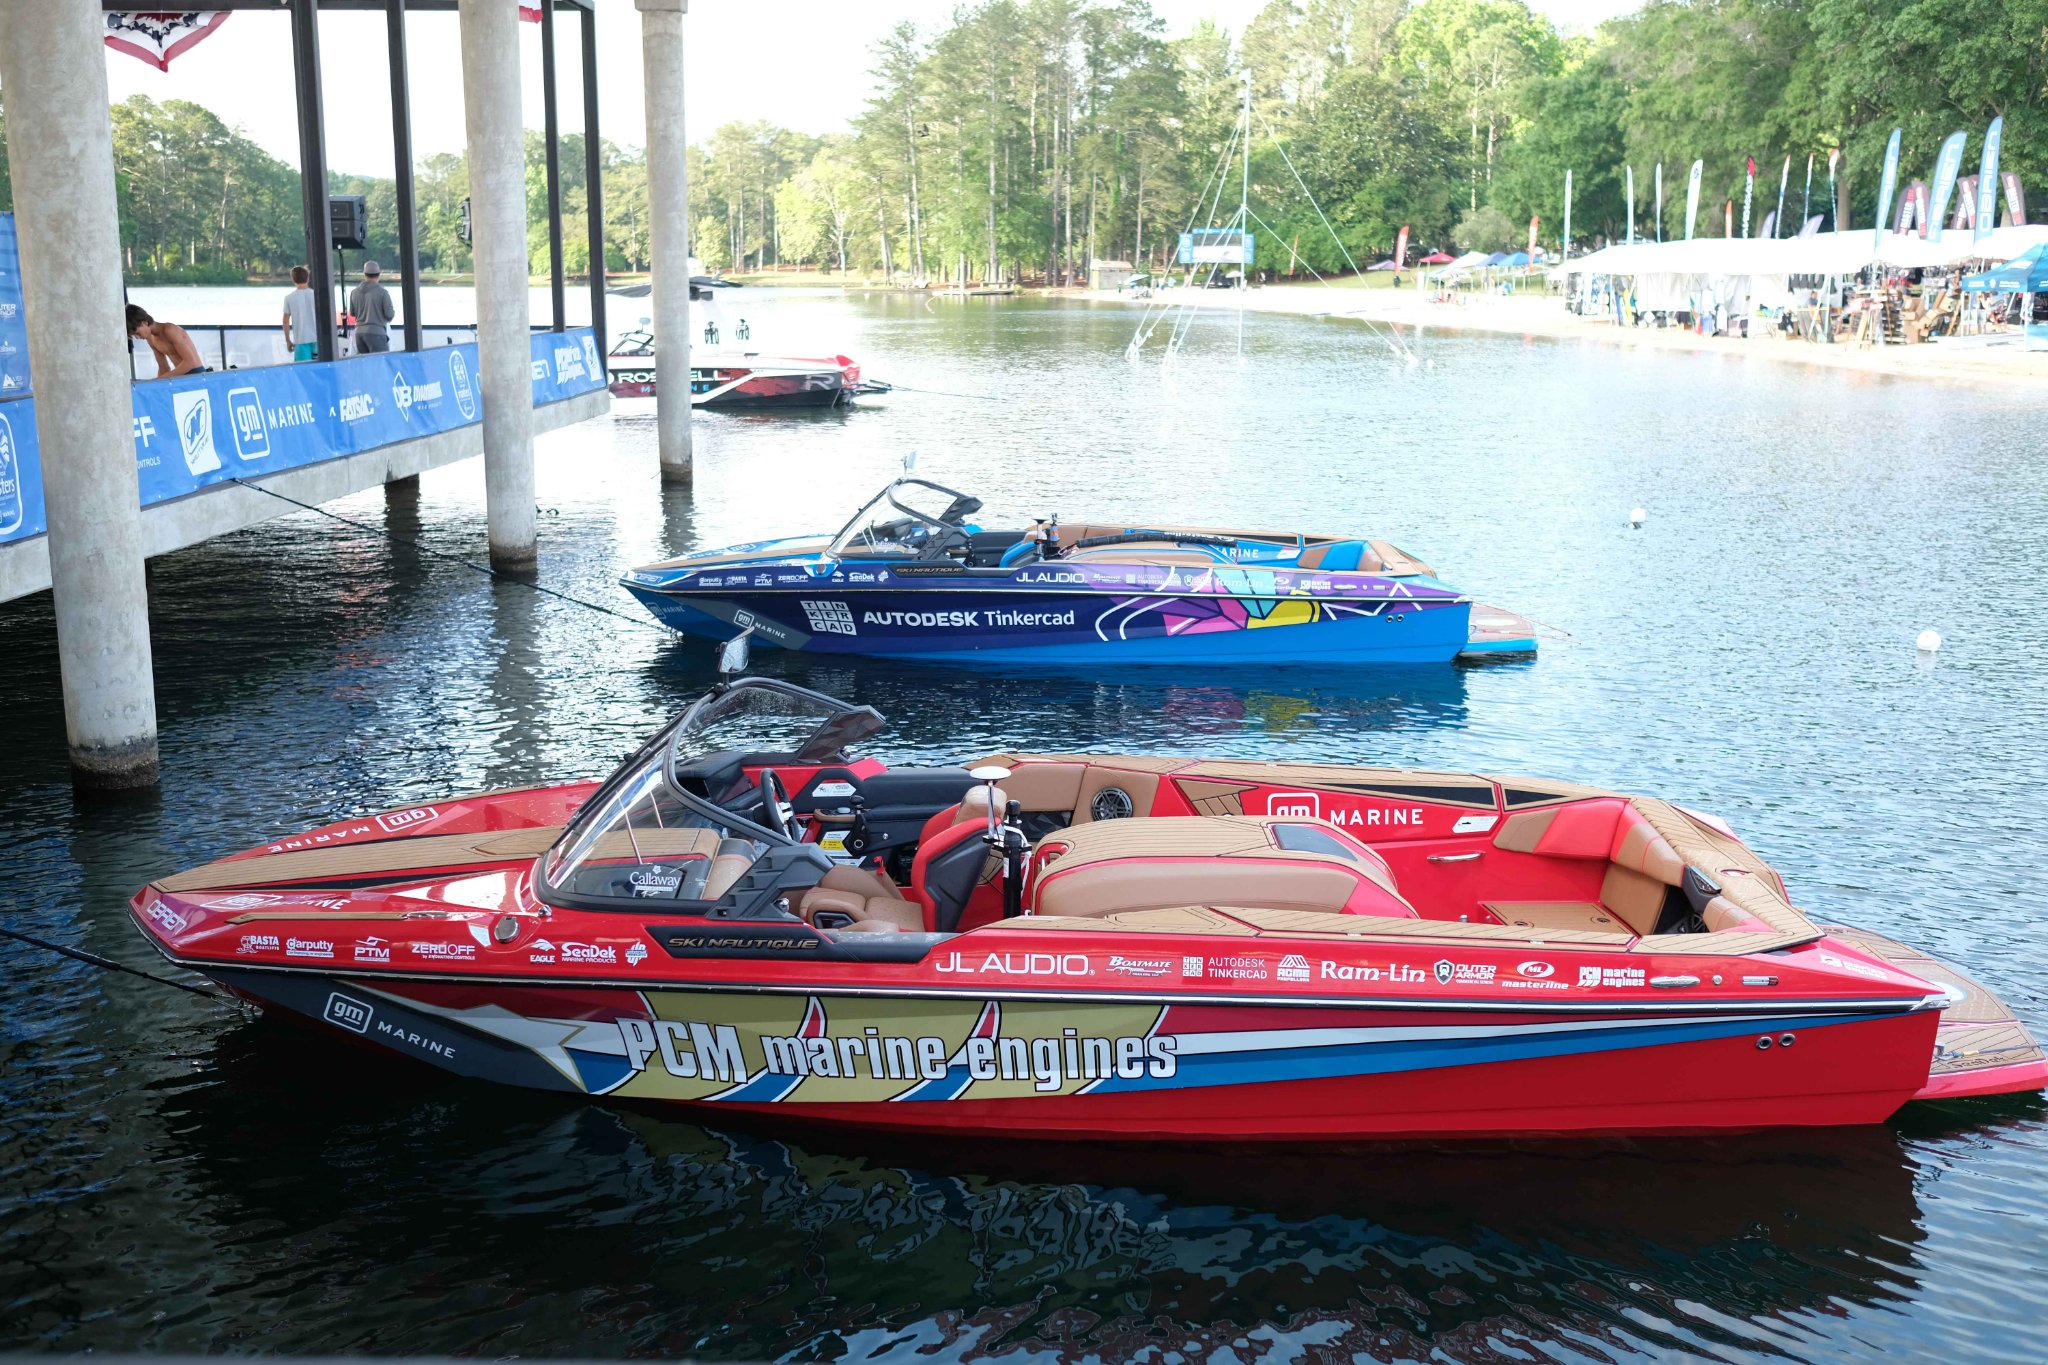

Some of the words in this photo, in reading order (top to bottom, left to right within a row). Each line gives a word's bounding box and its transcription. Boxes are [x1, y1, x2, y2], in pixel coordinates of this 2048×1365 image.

[267, 402, 315, 429] MARINE
[137, 456, 161, 470] ONTROLS
[1015, 573, 1034, 583] JL
[864, 611, 980, 628] AUTODESK
[985, 608, 1075, 628] Tinkercad
[754, 622, 786, 639] MARINE
[1330, 808, 1424, 826] MARINE
[268, 826, 371, 853] MARINE
[629, 871, 681, 889] Callaway
[250, 935, 280, 947] BASTA
[668, 938, 704, 947] SKI
[707, 938, 820, 950] NAUTIQUE
[354, 946, 390, 957] PTM
[561, 942, 616, 959] SeaDek
[530, 955, 555, 963] EAGLE
[936, 951, 974, 973] JL
[1208, 957, 1265, 968] AUTODESK
[1208, 968, 1267, 979] TINKERCAD
[1277, 968, 1310, 978] ACME
[1456, 964, 1497, 973] OUTER
[1528, 965, 1544, 973] ML
[1602, 966, 1646, 978] marine
[1455, 972, 1494, 980] ARMOR
[1501, 980, 1569, 990] masterline
[1602, 977, 1646, 988] engines
[334, 1000, 364, 1025] gm
[377, 1021, 456, 1059] MARINE
[616, 1017, 749, 1084] PCM
[761, 1026, 948, 1080] marine
[966, 1027, 1179, 1093] engines
